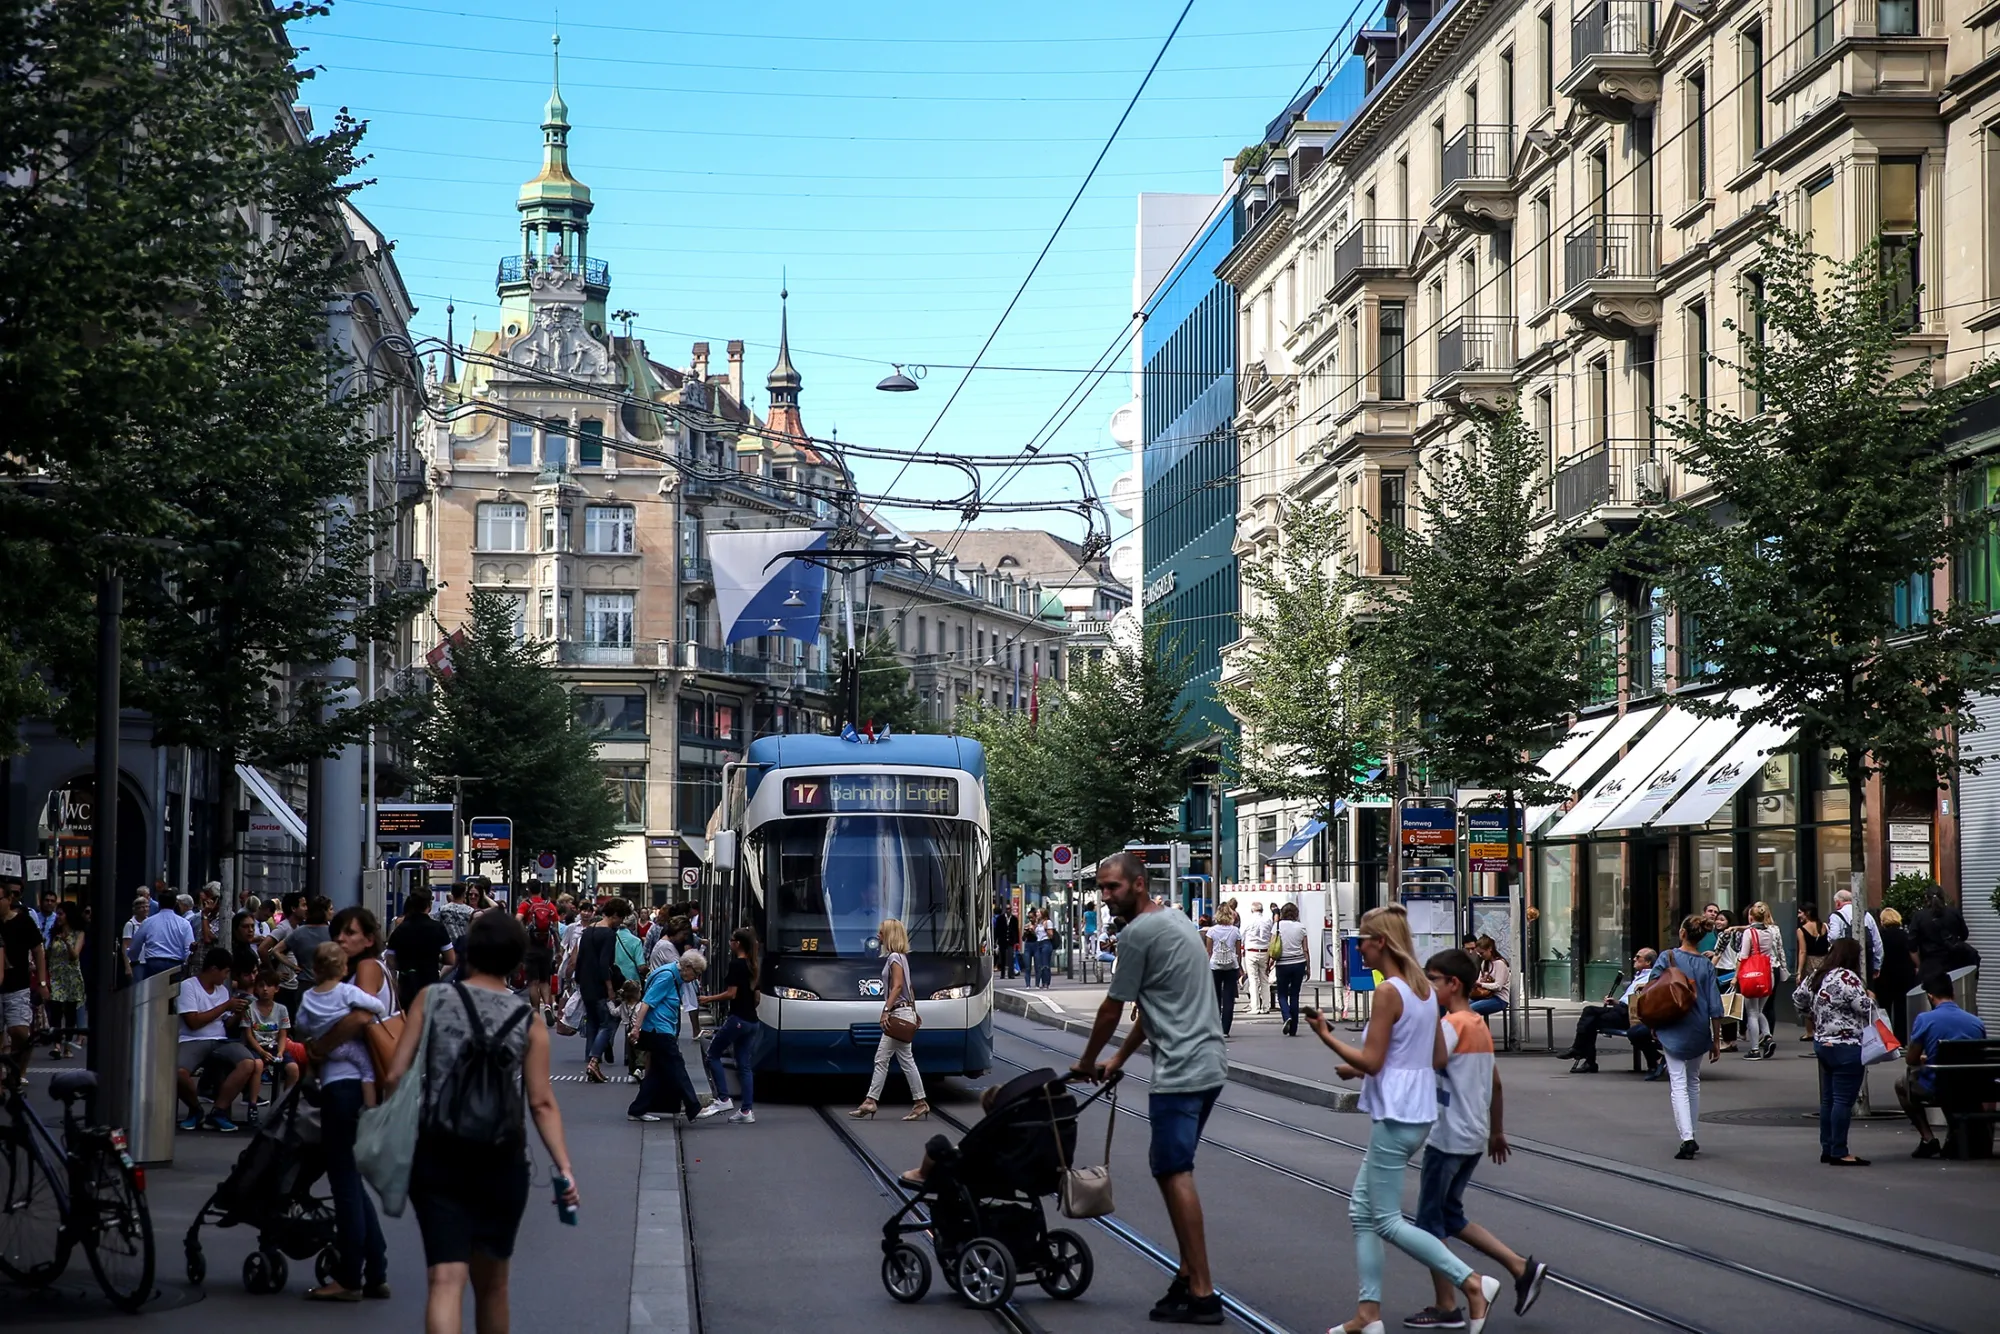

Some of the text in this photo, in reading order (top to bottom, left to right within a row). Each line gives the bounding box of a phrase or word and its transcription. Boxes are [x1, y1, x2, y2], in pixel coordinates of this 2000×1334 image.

[793, 783, 949, 803] 17 Bahnhof Enge
[251, 823, 281, 831] Sunrise
[1403, 820, 1432, 828] Rennweg
[1471, 819, 1499, 827] Rennweg
[1409, 834, 1416, 843] 6
[1474, 834, 1483, 842] 11
[1409, 849, 1416, 858] 7
[1473, 848, 1483, 856] 13
[1473, 863, 1483, 871] 17
